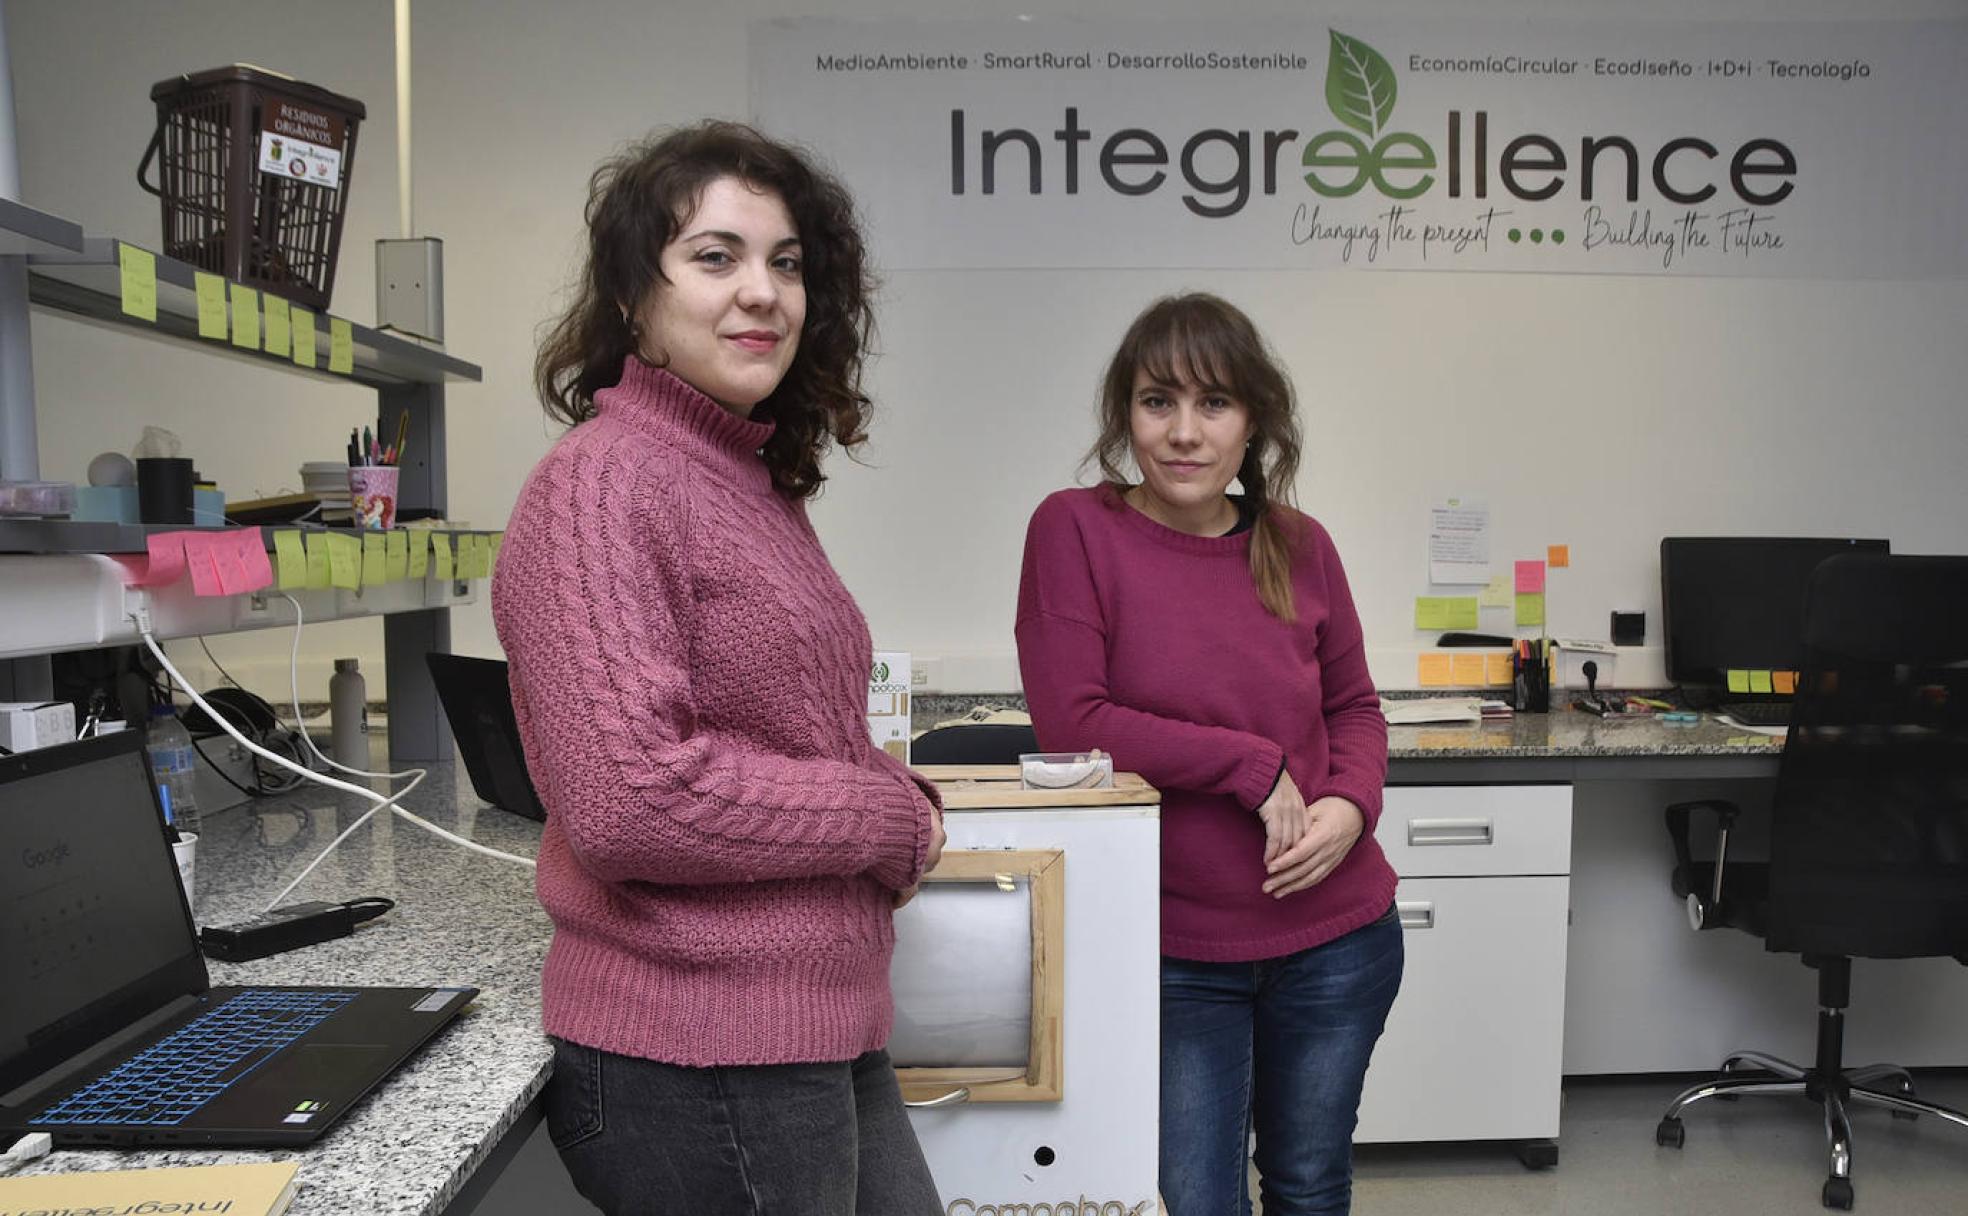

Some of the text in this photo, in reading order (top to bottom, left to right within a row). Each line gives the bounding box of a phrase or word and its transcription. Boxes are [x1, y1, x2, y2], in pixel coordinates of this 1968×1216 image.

[816, 52, 1308, 71] MedioAmbiente SmartRural DesarrolloSostenible
[1409, 54, 1579, 74] EconomíaCircular
[1594, 57, 1693, 76] Ecodiseño
[1767, 59, 1871, 80] Tecnología
[1291, 203, 1514, 263] Changing the present
[1582, 205, 1785, 268] Building the Future
